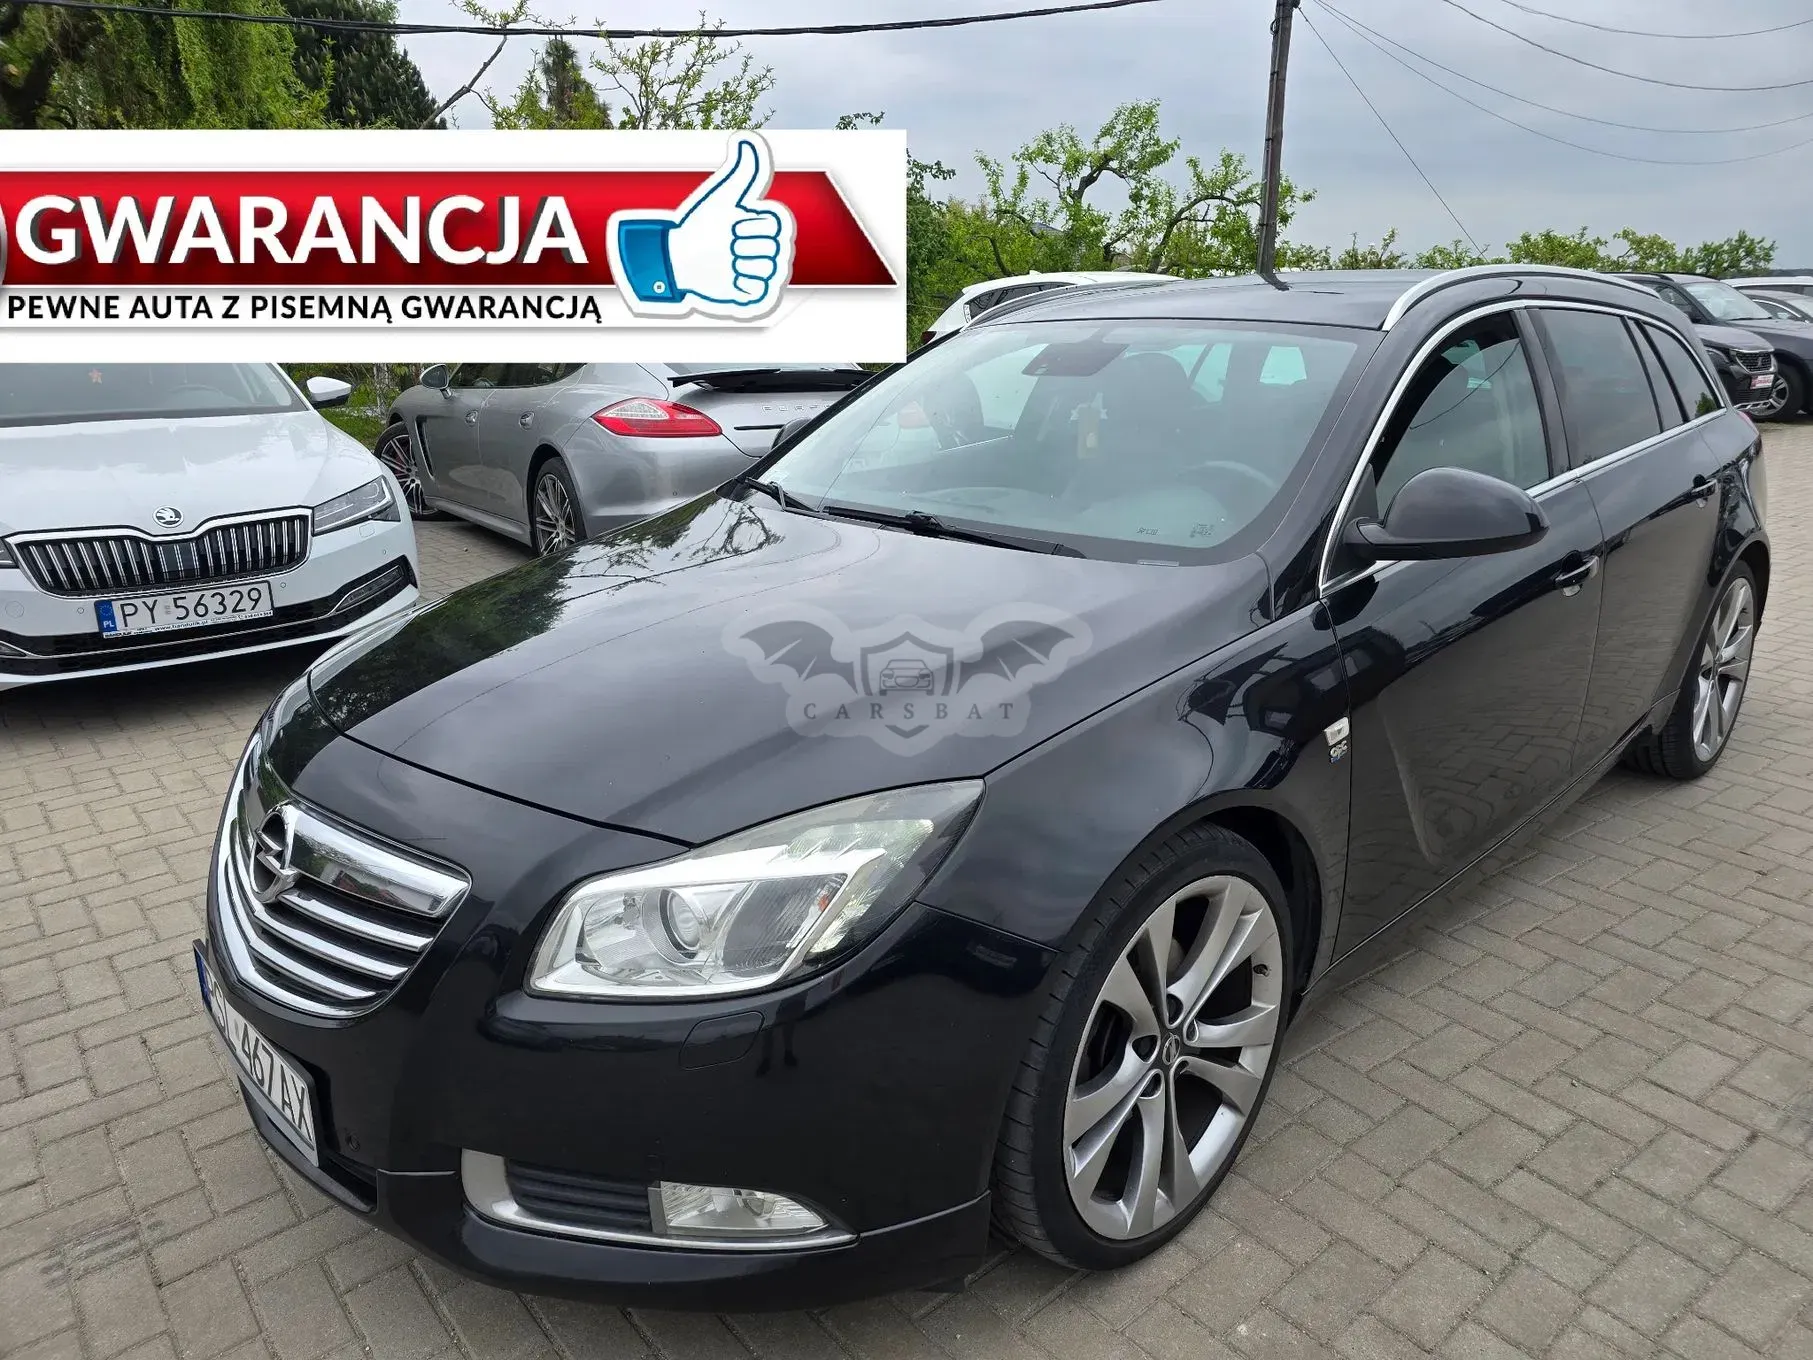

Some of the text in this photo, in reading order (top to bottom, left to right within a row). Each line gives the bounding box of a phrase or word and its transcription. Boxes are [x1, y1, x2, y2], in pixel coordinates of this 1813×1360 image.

[103, 620, 115, 629] PL
[120, 587, 262, 628] PY 56329
[241, 1022, 312, 1142] 467AX
